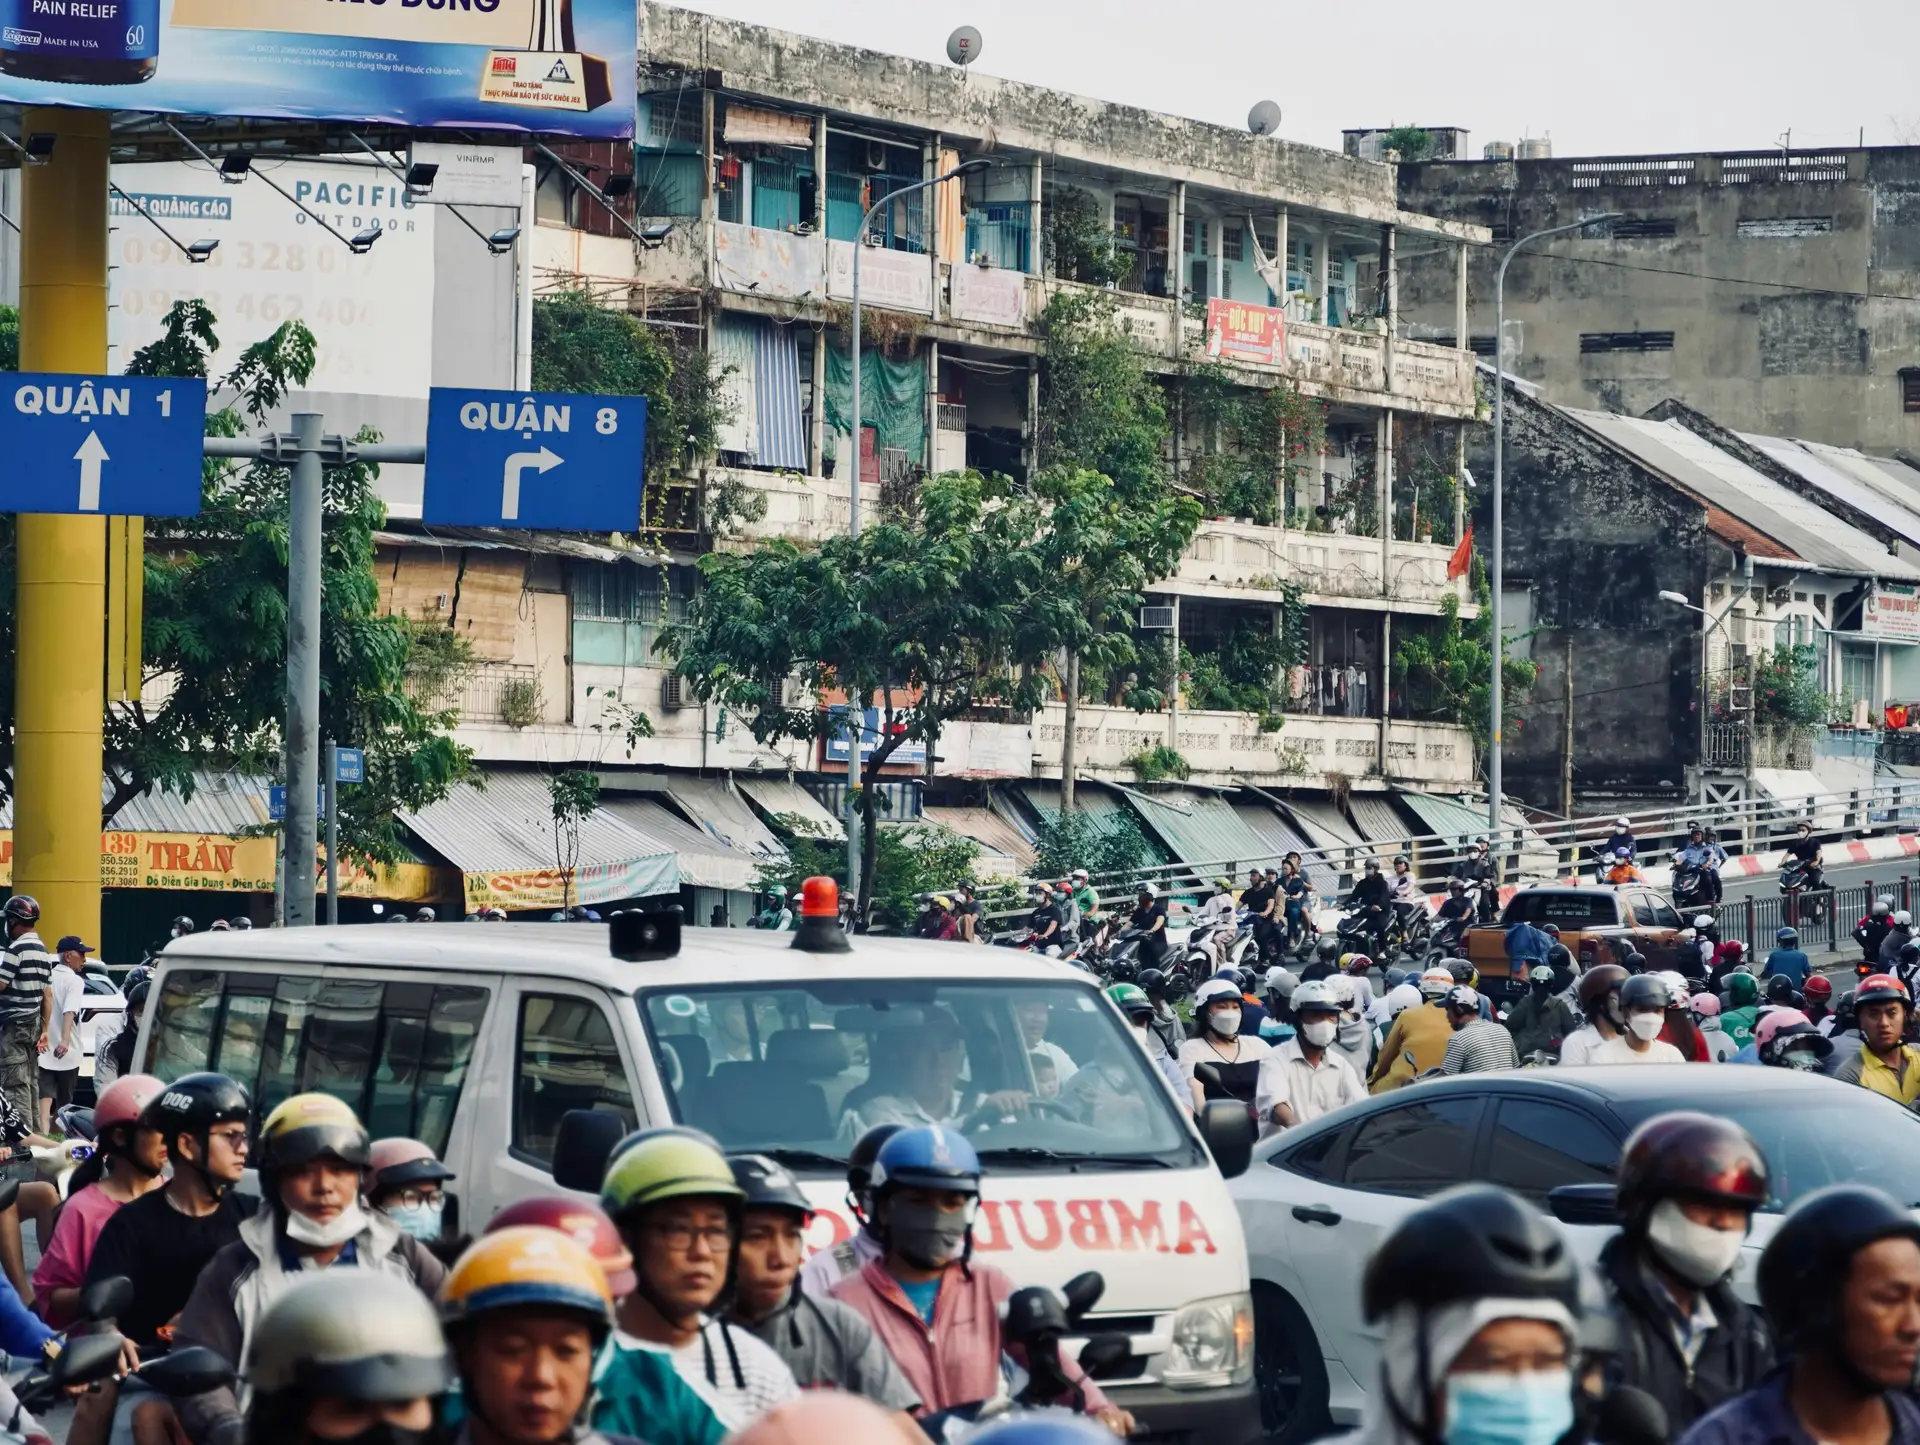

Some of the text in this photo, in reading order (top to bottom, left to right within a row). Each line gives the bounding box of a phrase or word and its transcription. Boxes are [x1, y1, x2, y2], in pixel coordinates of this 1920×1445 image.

[32, 0, 118, 18] PAIN RELIEF
[3, 29, 41, 44] Ecogreen
[82, 39, 99, 48] USA
[125, 24, 145, 46] 60
[376, 63, 392, 73] thay
[570, 95, 581, 104] JEX
[295, 180, 416, 210] PACIFIC
[149, 195, 199, 216] QUẢNG
[201, 198, 229, 216] CÁO
[295, 212, 415, 232] OUTDOOR
[14, 380, 172, 422] QUẬN 1
[460, 396, 618, 440] QUẬN 8
[101, 833, 137, 855] 139
[184, 876, 199, 887] Gia
